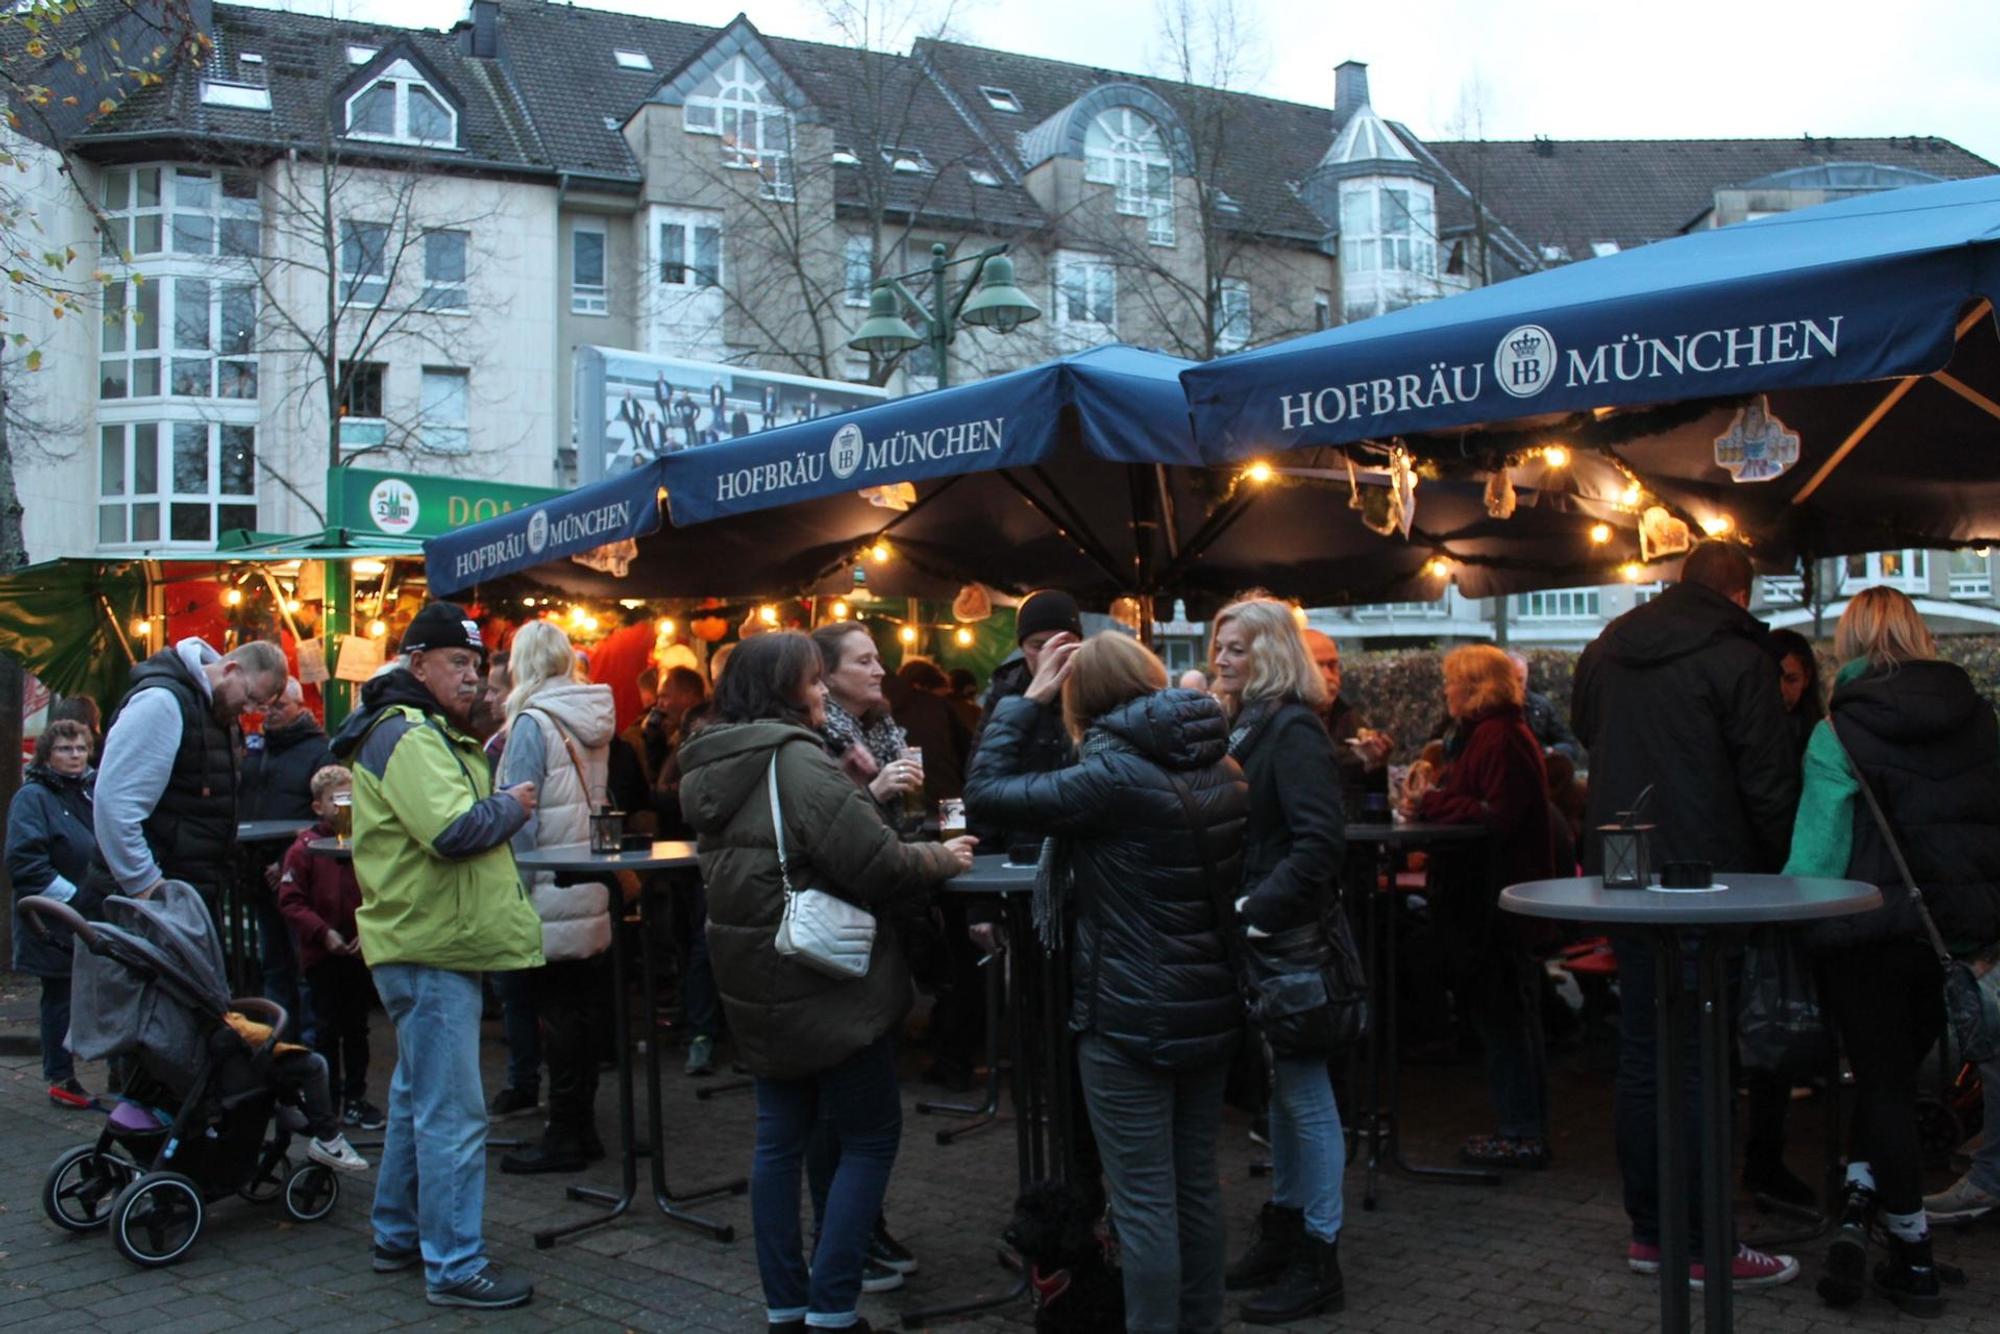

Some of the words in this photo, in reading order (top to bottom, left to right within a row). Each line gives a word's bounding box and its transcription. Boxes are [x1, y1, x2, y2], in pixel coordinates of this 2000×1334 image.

[1279, 361, 1485, 431] HOFBRÄU
[1511, 358, 1541, 387] HB
[1565, 315, 1844, 388] MÜNCHEN
[716, 452, 825, 501] HOFBRÄU
[864, 417, 1005, 471] MÜNCHEN
[456, 533, 526, 577] HOFBRÄU
[549, 500, 631, 547] MÜNCHEN
